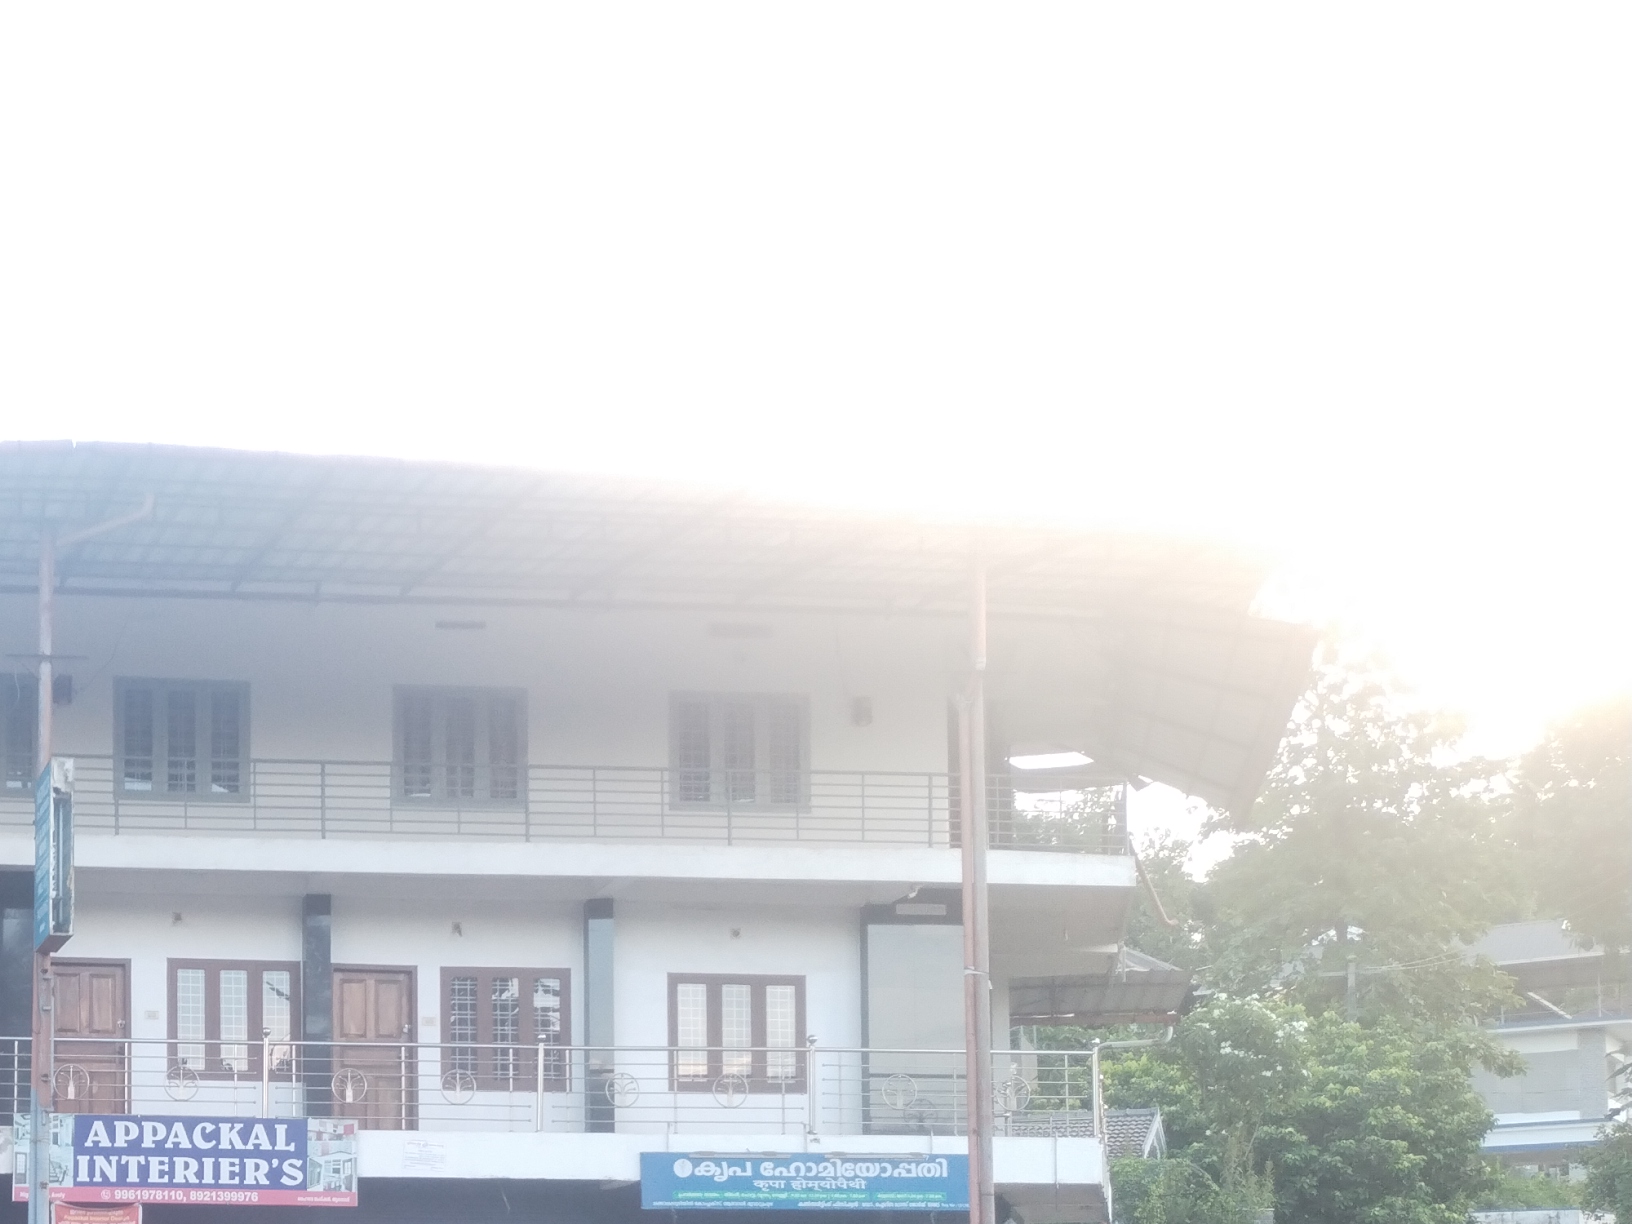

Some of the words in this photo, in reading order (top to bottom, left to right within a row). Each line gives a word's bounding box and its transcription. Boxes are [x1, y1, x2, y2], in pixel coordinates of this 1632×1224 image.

[84, 1120, 295, 1152] APPACKAL
[77, 1154, 304, 1186] INTERIER'S
[694, 1161, 752, 1182] കൃപ
[760, 1159, 948, 1177] ഹോമിയോപ്പതി
[114, 1190, 187, 1202] 9961978110,
[189, 1191, 258, 1202] 8921399976
[753, 1180, 786, 1191] कृपा
